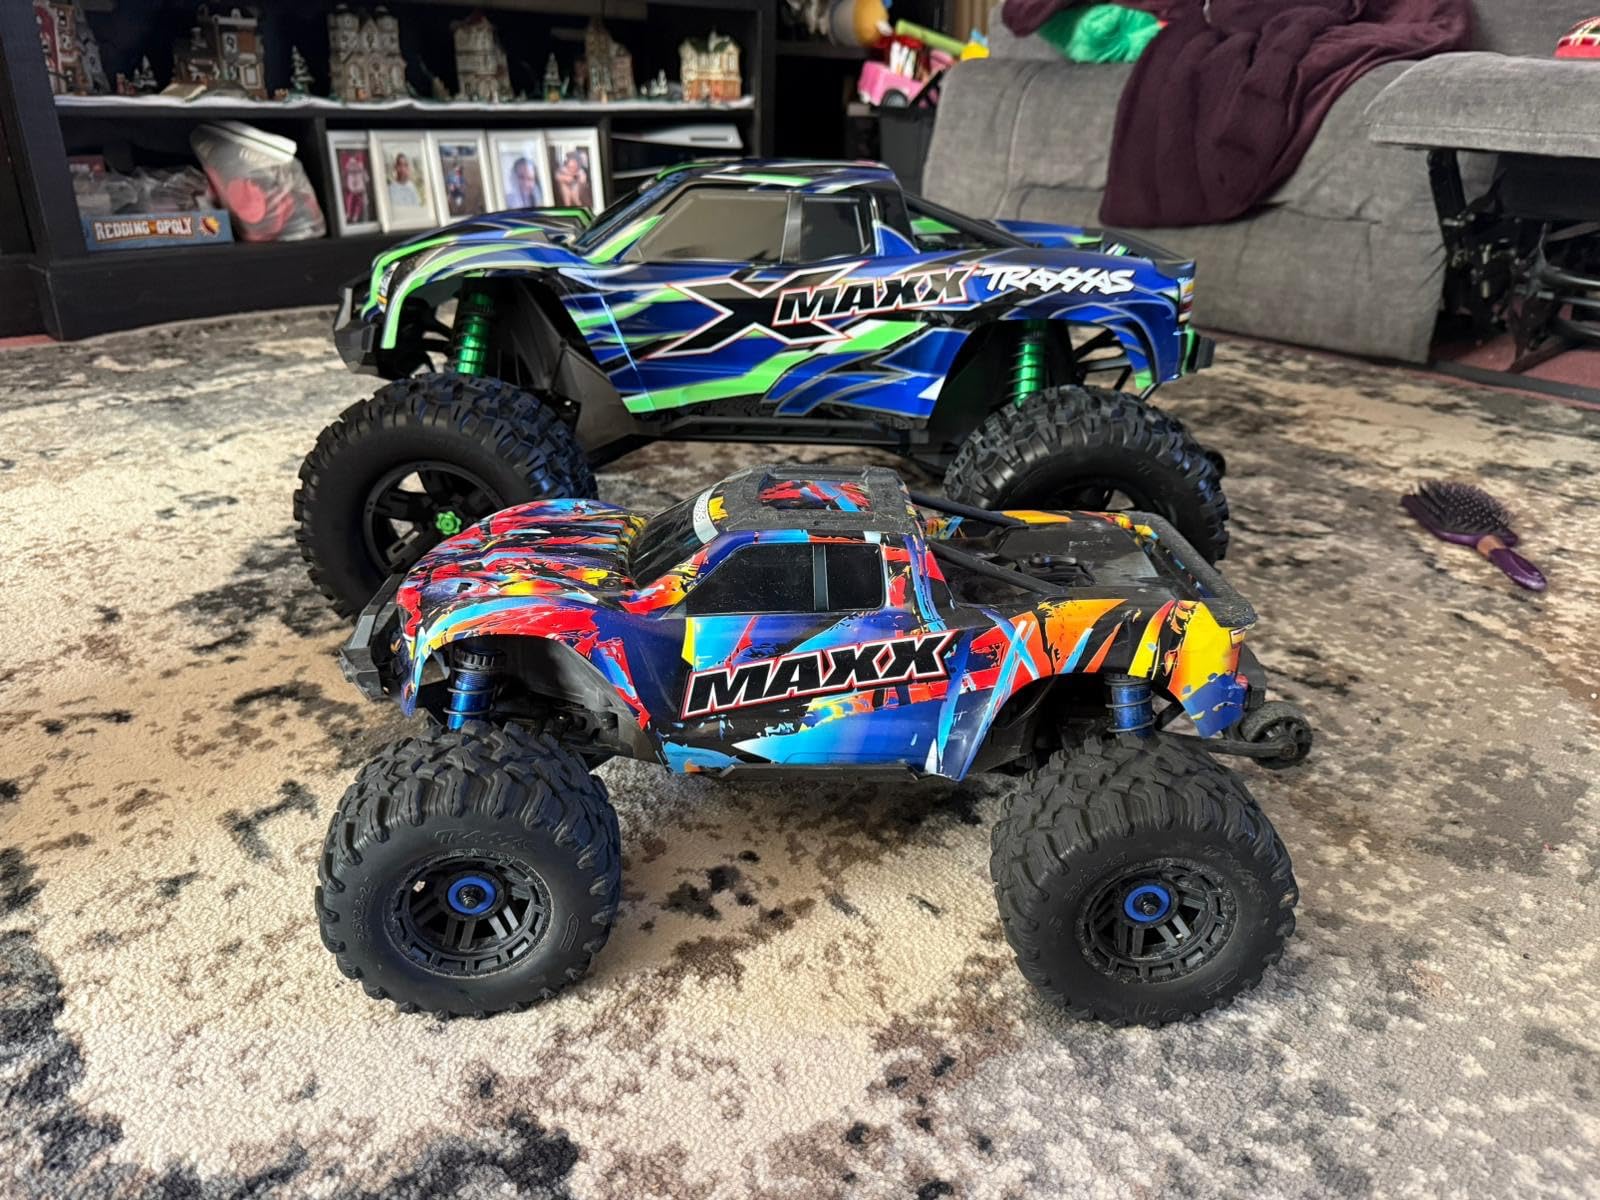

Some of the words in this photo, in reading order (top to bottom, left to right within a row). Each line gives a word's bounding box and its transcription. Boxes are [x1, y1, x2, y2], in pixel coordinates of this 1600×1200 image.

[772, 265, 978, 325] MAXX
[981, 266, 1135, 295] TRAXXAS
[682, 630, 956, 719] MAXX
